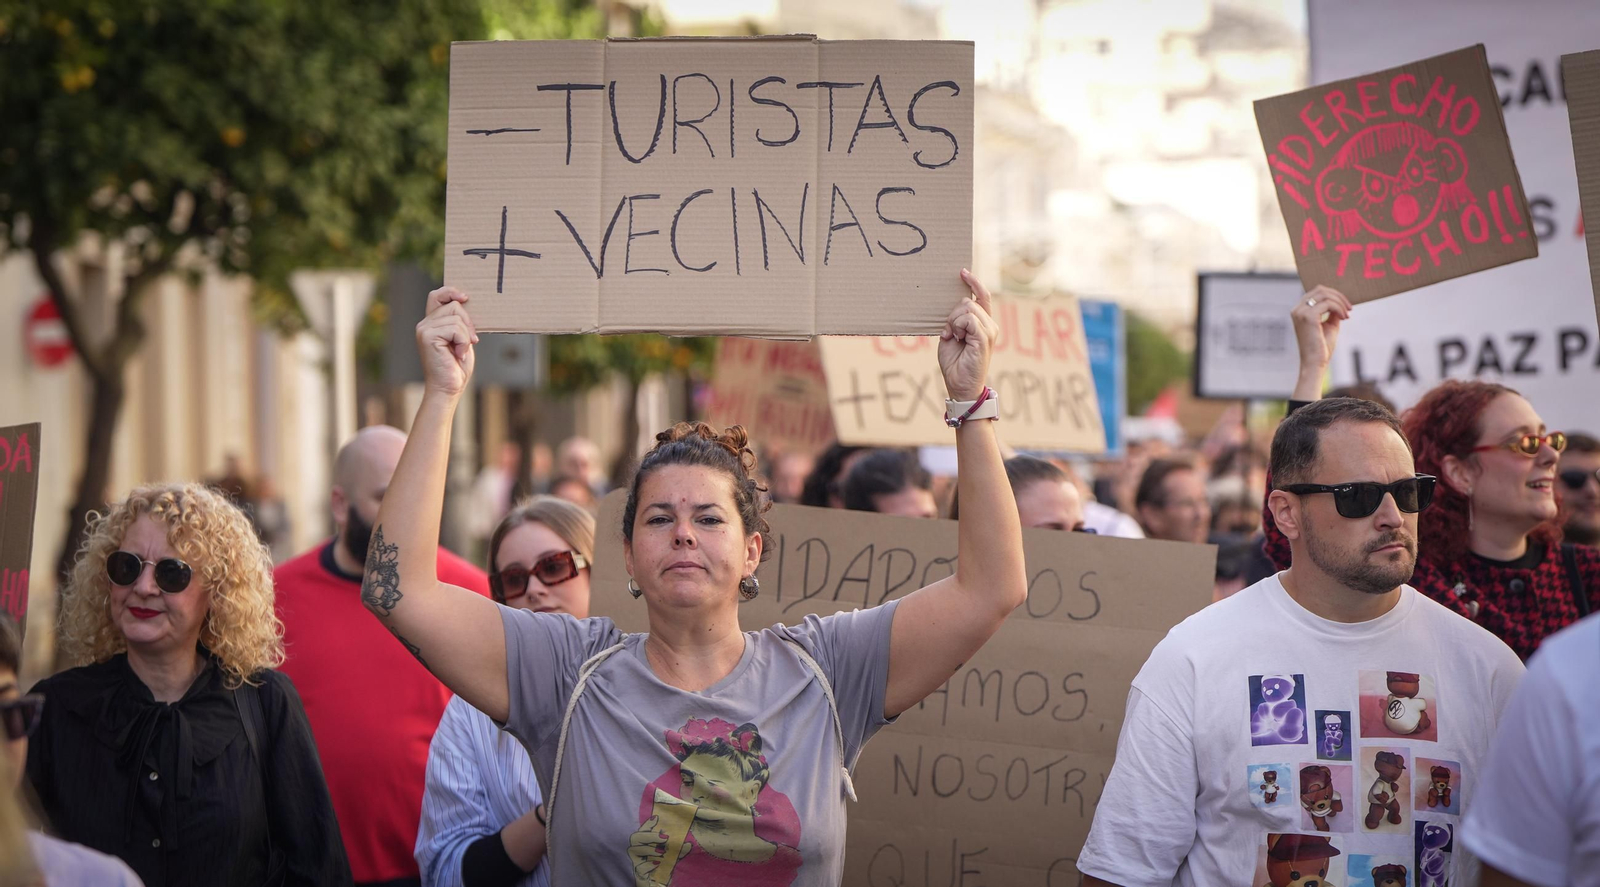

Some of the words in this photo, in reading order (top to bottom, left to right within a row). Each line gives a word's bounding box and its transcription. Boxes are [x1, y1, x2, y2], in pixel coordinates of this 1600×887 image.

[1301, 217, 1326, 256] A
[1352, 343, 1418, 384] LA
[1437, 333, 1538, 380] PAZ
